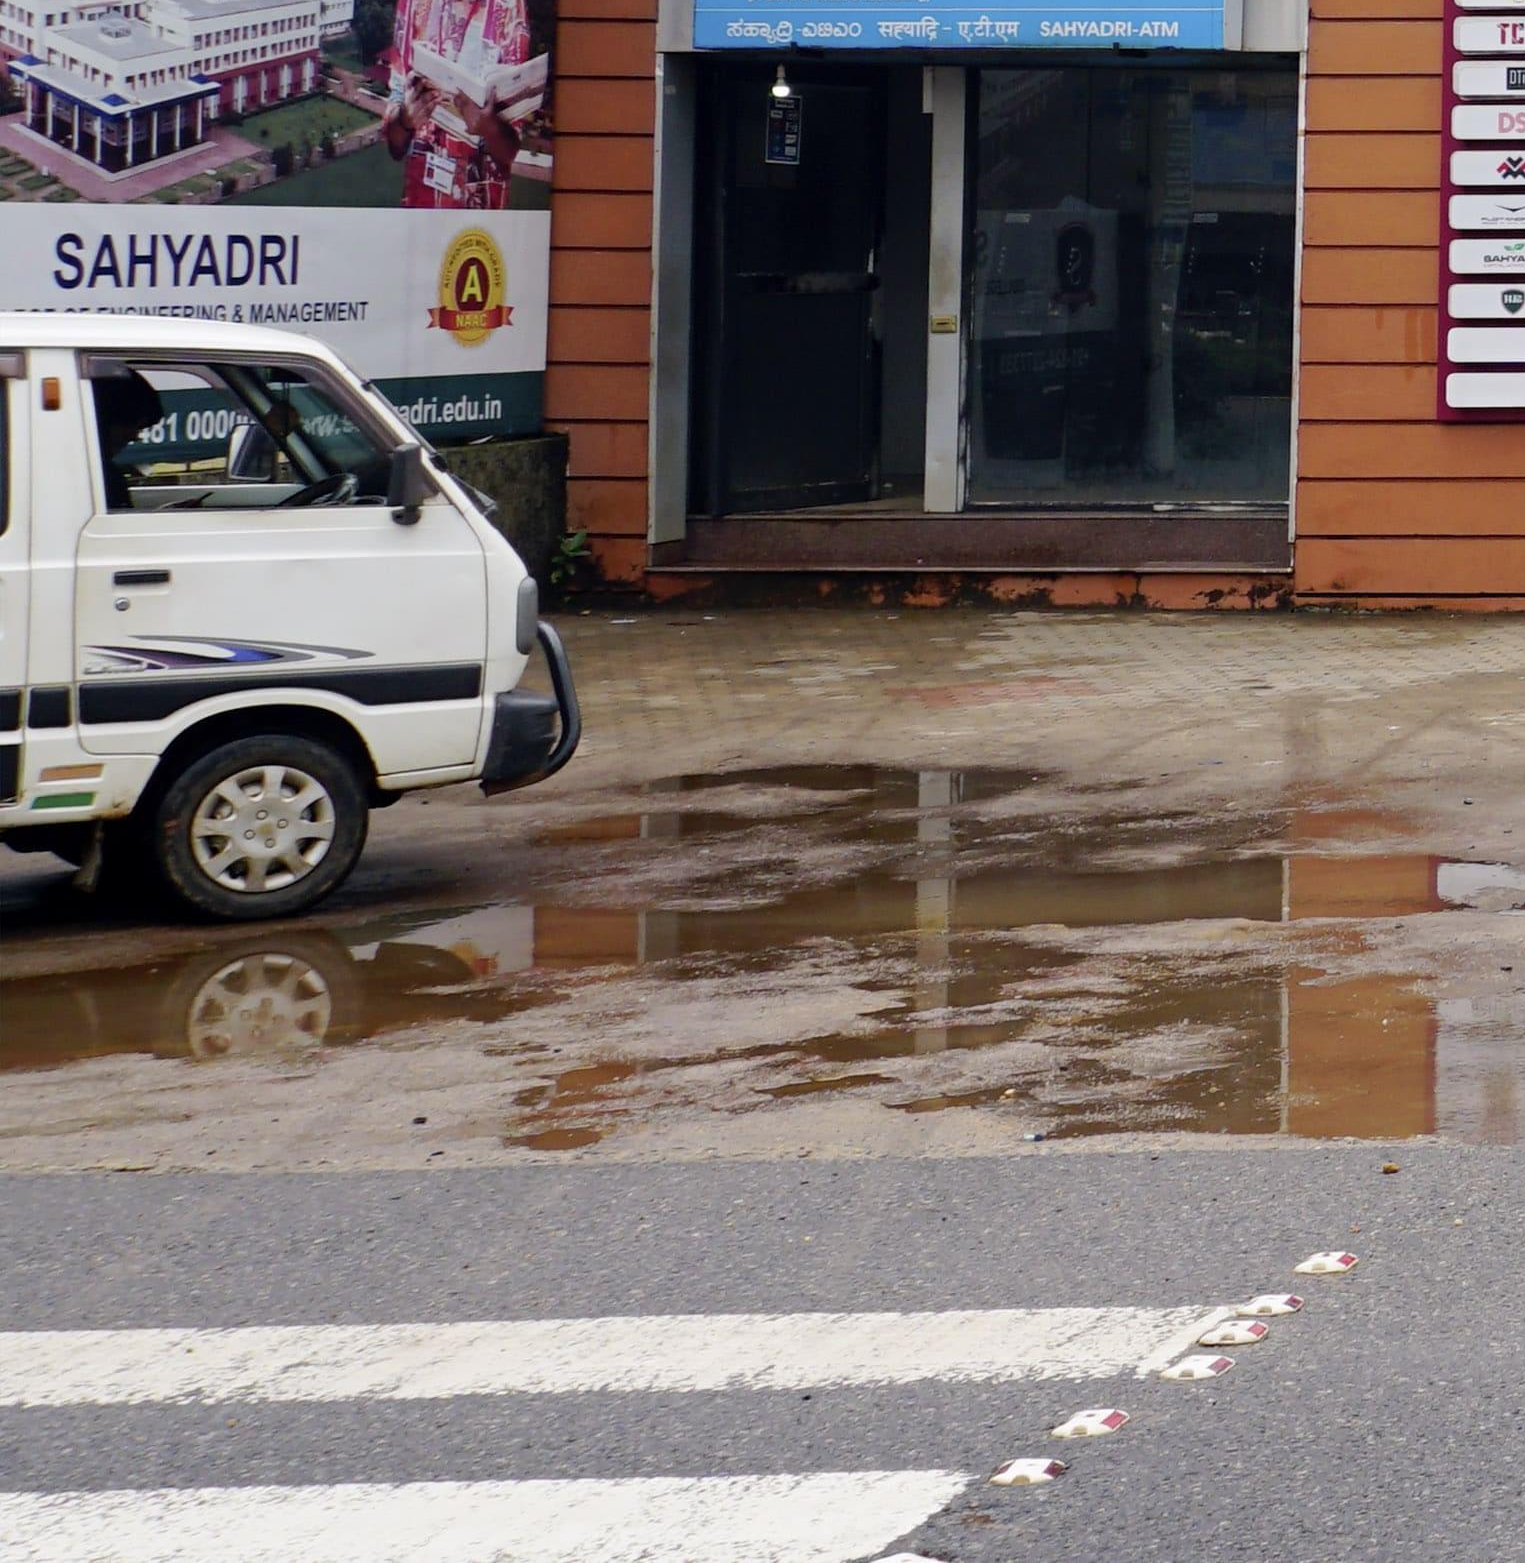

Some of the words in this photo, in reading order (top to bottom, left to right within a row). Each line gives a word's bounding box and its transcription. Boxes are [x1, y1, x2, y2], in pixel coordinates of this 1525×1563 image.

[1039, 20, 1179, 38] SAHYADRI-ATM
[53, 232, 300, 290] SAHYADRI
[461, 265, 483, 303] A
[248, 301, 369, 324] MANAGEMENT
[456, 313, 488, 327] NAAC
